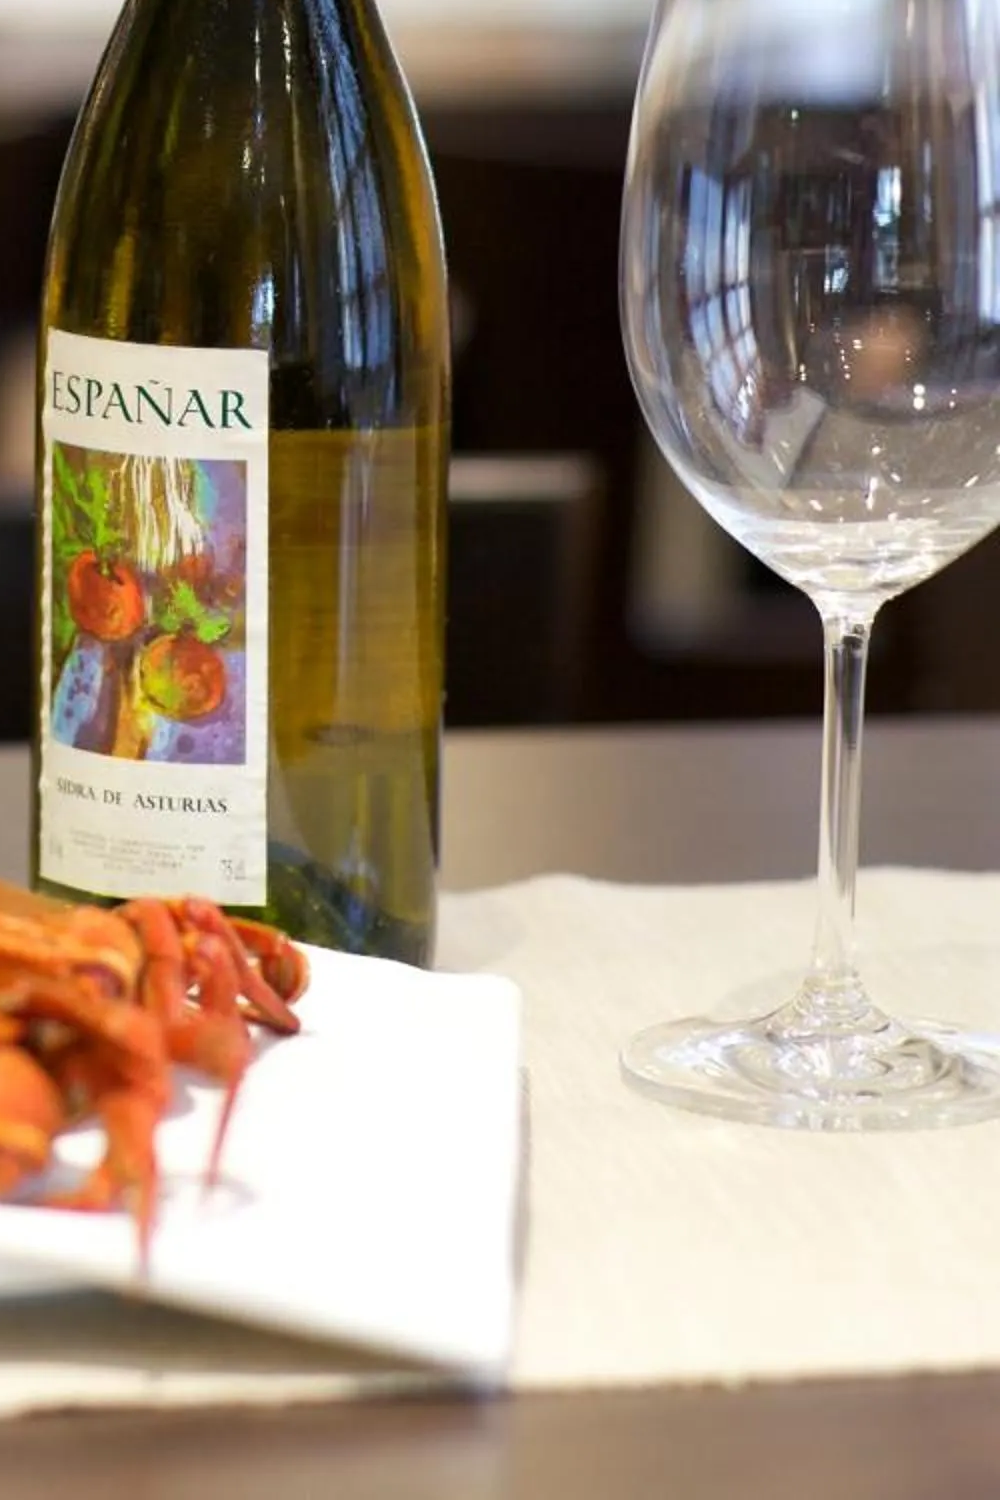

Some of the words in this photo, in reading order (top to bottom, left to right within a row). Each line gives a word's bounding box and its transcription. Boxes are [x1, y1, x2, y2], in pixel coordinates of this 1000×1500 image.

[52, 371, 252, 429] ESPAÑAR
[56, 776, 96, 801] SIDRA
[103, 788, 122, 806] DE
[134, 793, 228, 814] ASTURIAS
